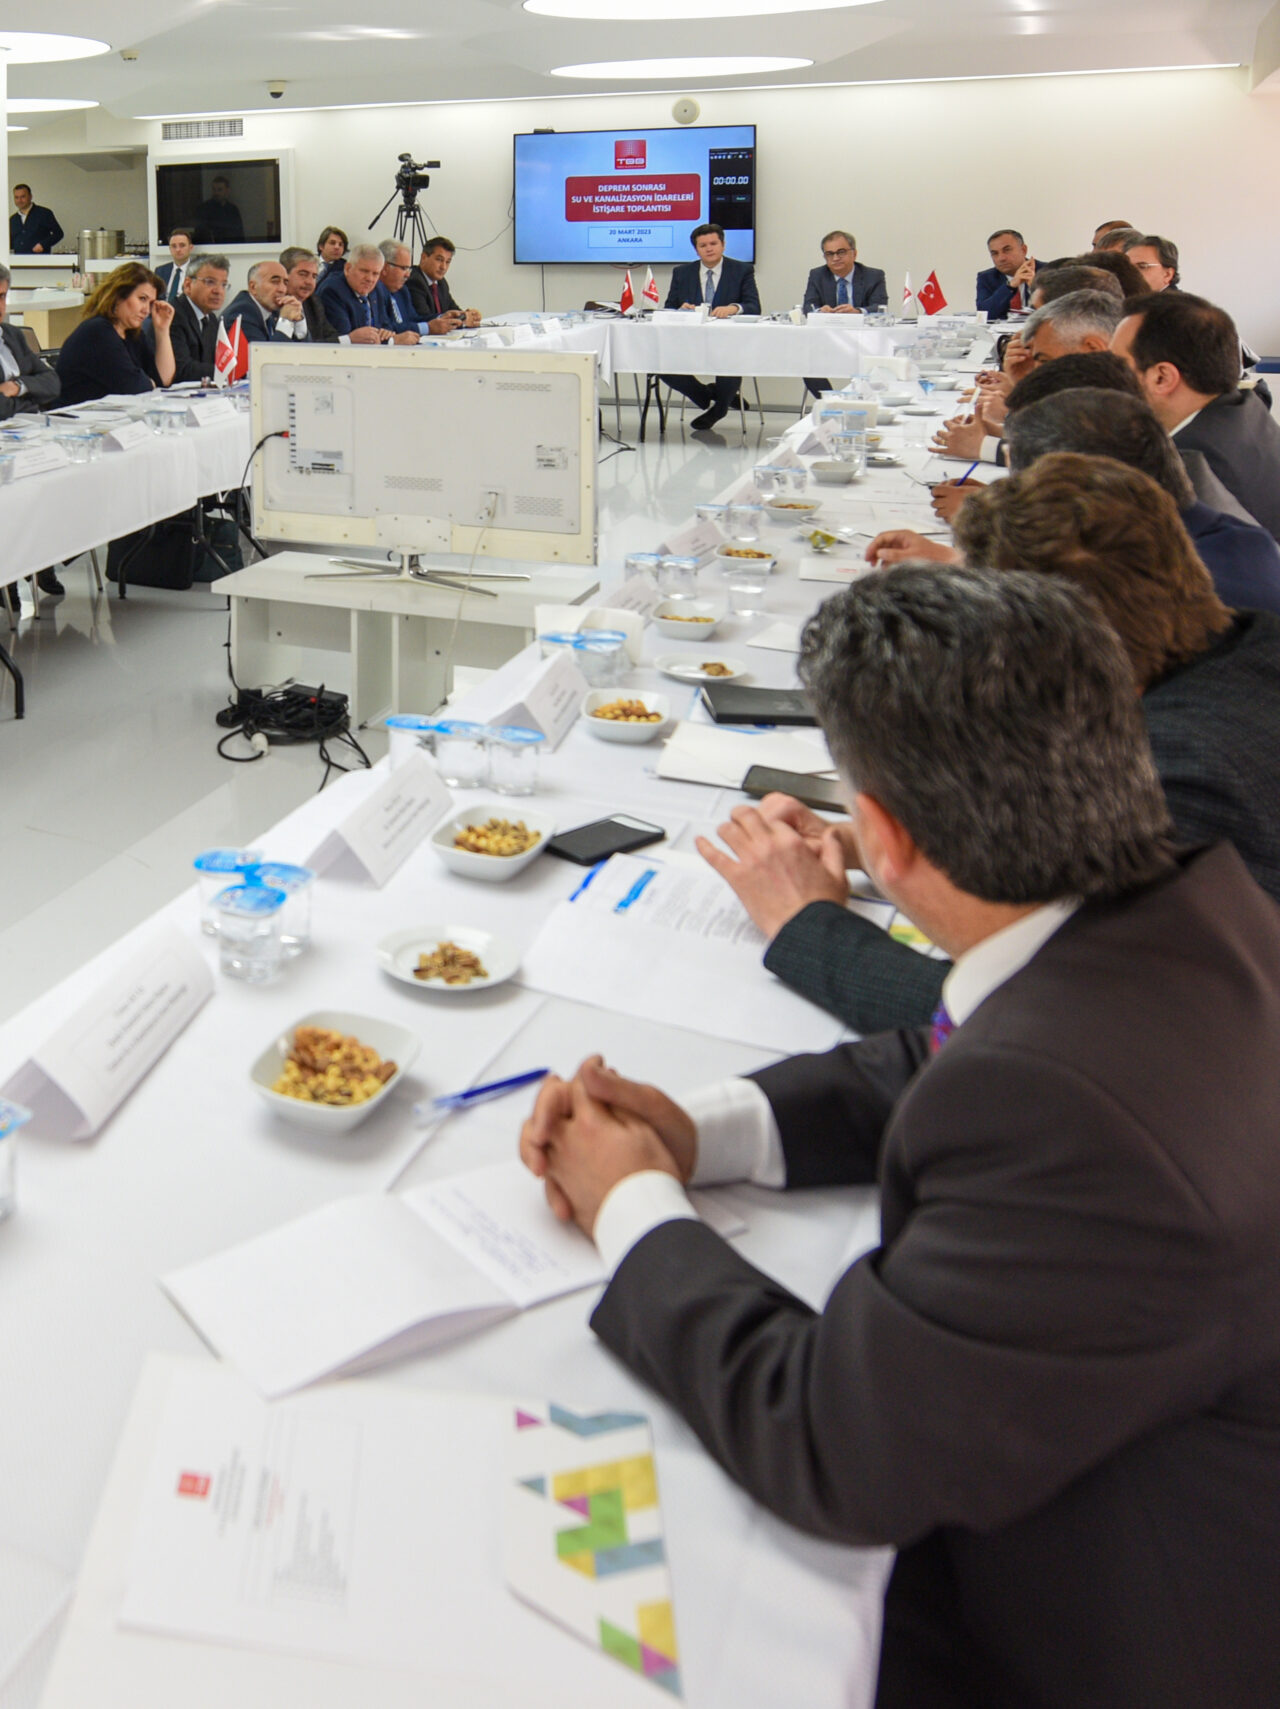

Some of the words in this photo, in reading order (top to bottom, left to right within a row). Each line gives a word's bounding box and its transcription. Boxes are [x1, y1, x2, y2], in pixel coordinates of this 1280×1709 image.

[598, 184, 630, 192] DEPREM
[631, 183, 666, 191] SONRASI
[571, 195, 582, 203] SU
[583, 195, 593, 203] VE
[595, 193, 652, 203] KANALİZASYON
[654, 192, 694, 201] İDARELERİ
[593, 204, 625, 214] İSTİŞARE
[627, 204, 671, 212] TOPLANTISI
